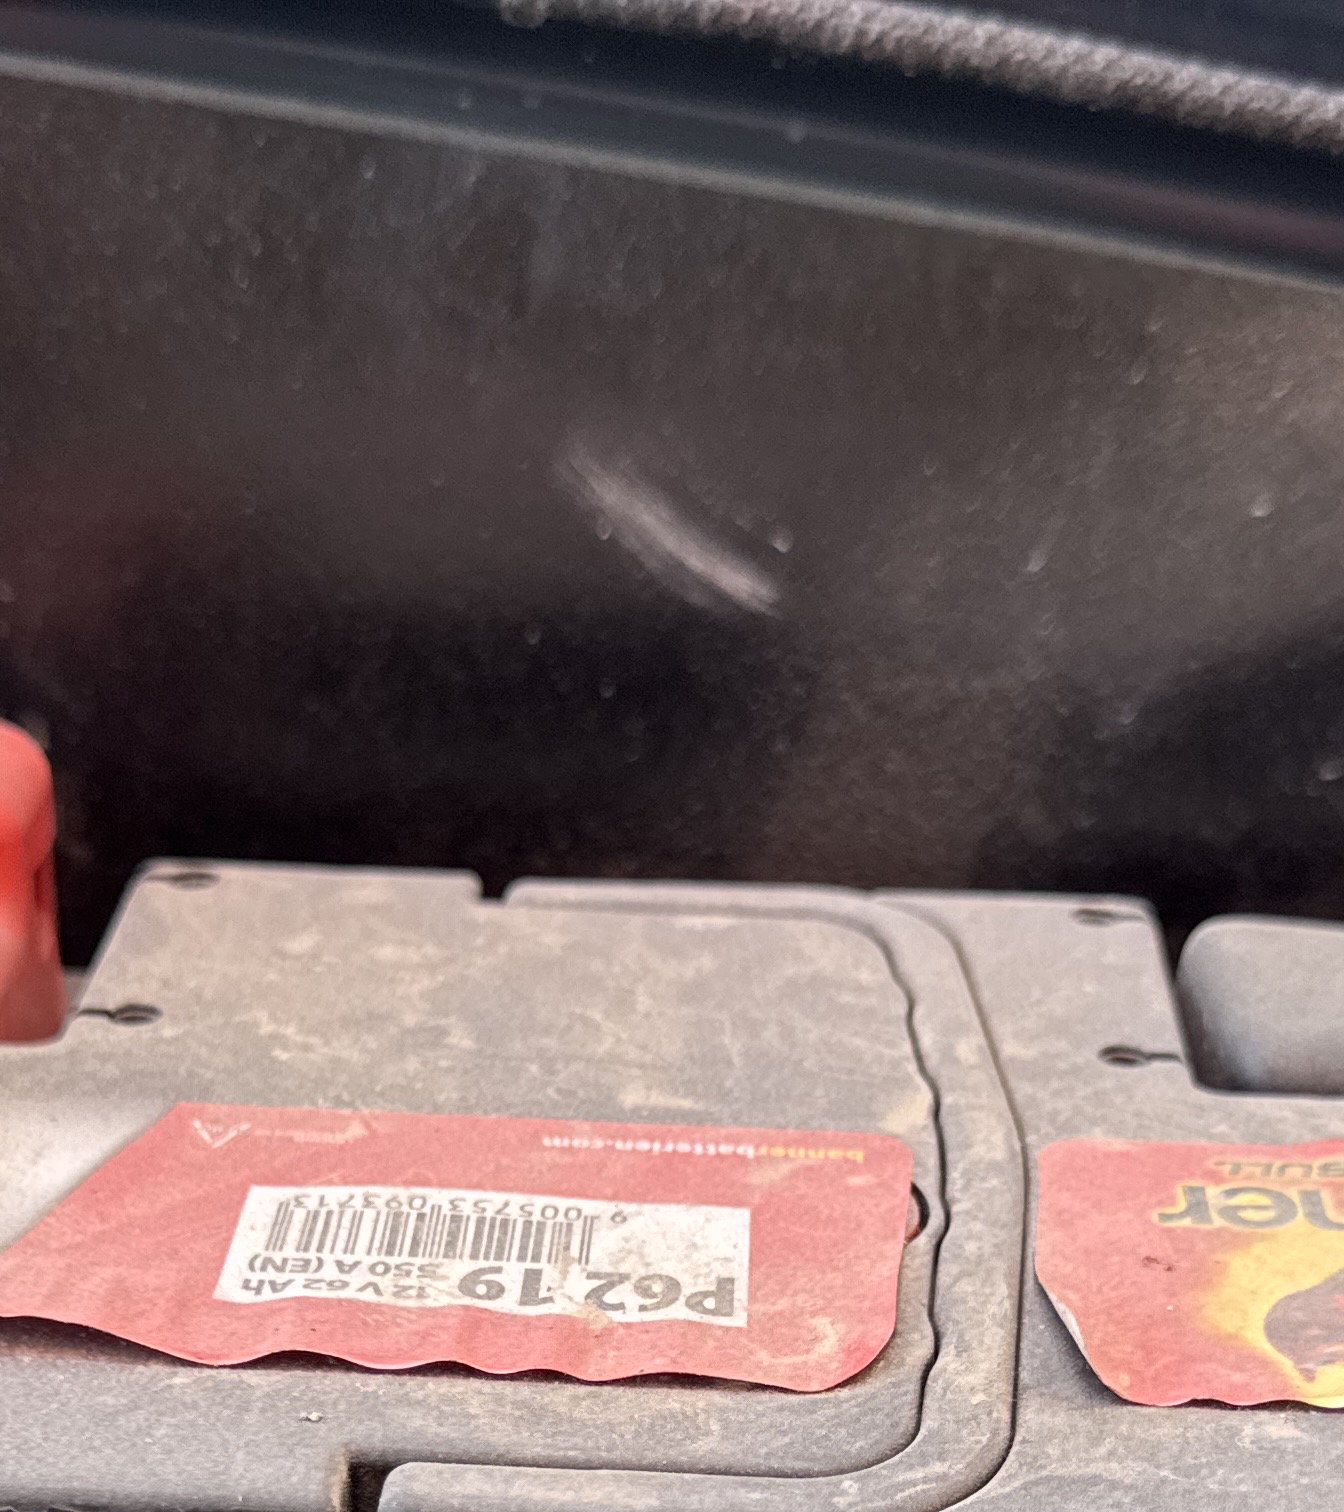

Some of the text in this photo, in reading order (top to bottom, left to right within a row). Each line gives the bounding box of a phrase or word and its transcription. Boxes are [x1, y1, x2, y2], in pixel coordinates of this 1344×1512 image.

[542, 1136, 864, 1163] bannerbatterien.com
[292, 1192, 629, 1226] 9 005753 093713
[248, 1253, 441, 1280] 550 A (EN)
[241, 1275, 429, 1299] 12 V 62 Ah
[457, 1265, 737, 1318] P62 19
